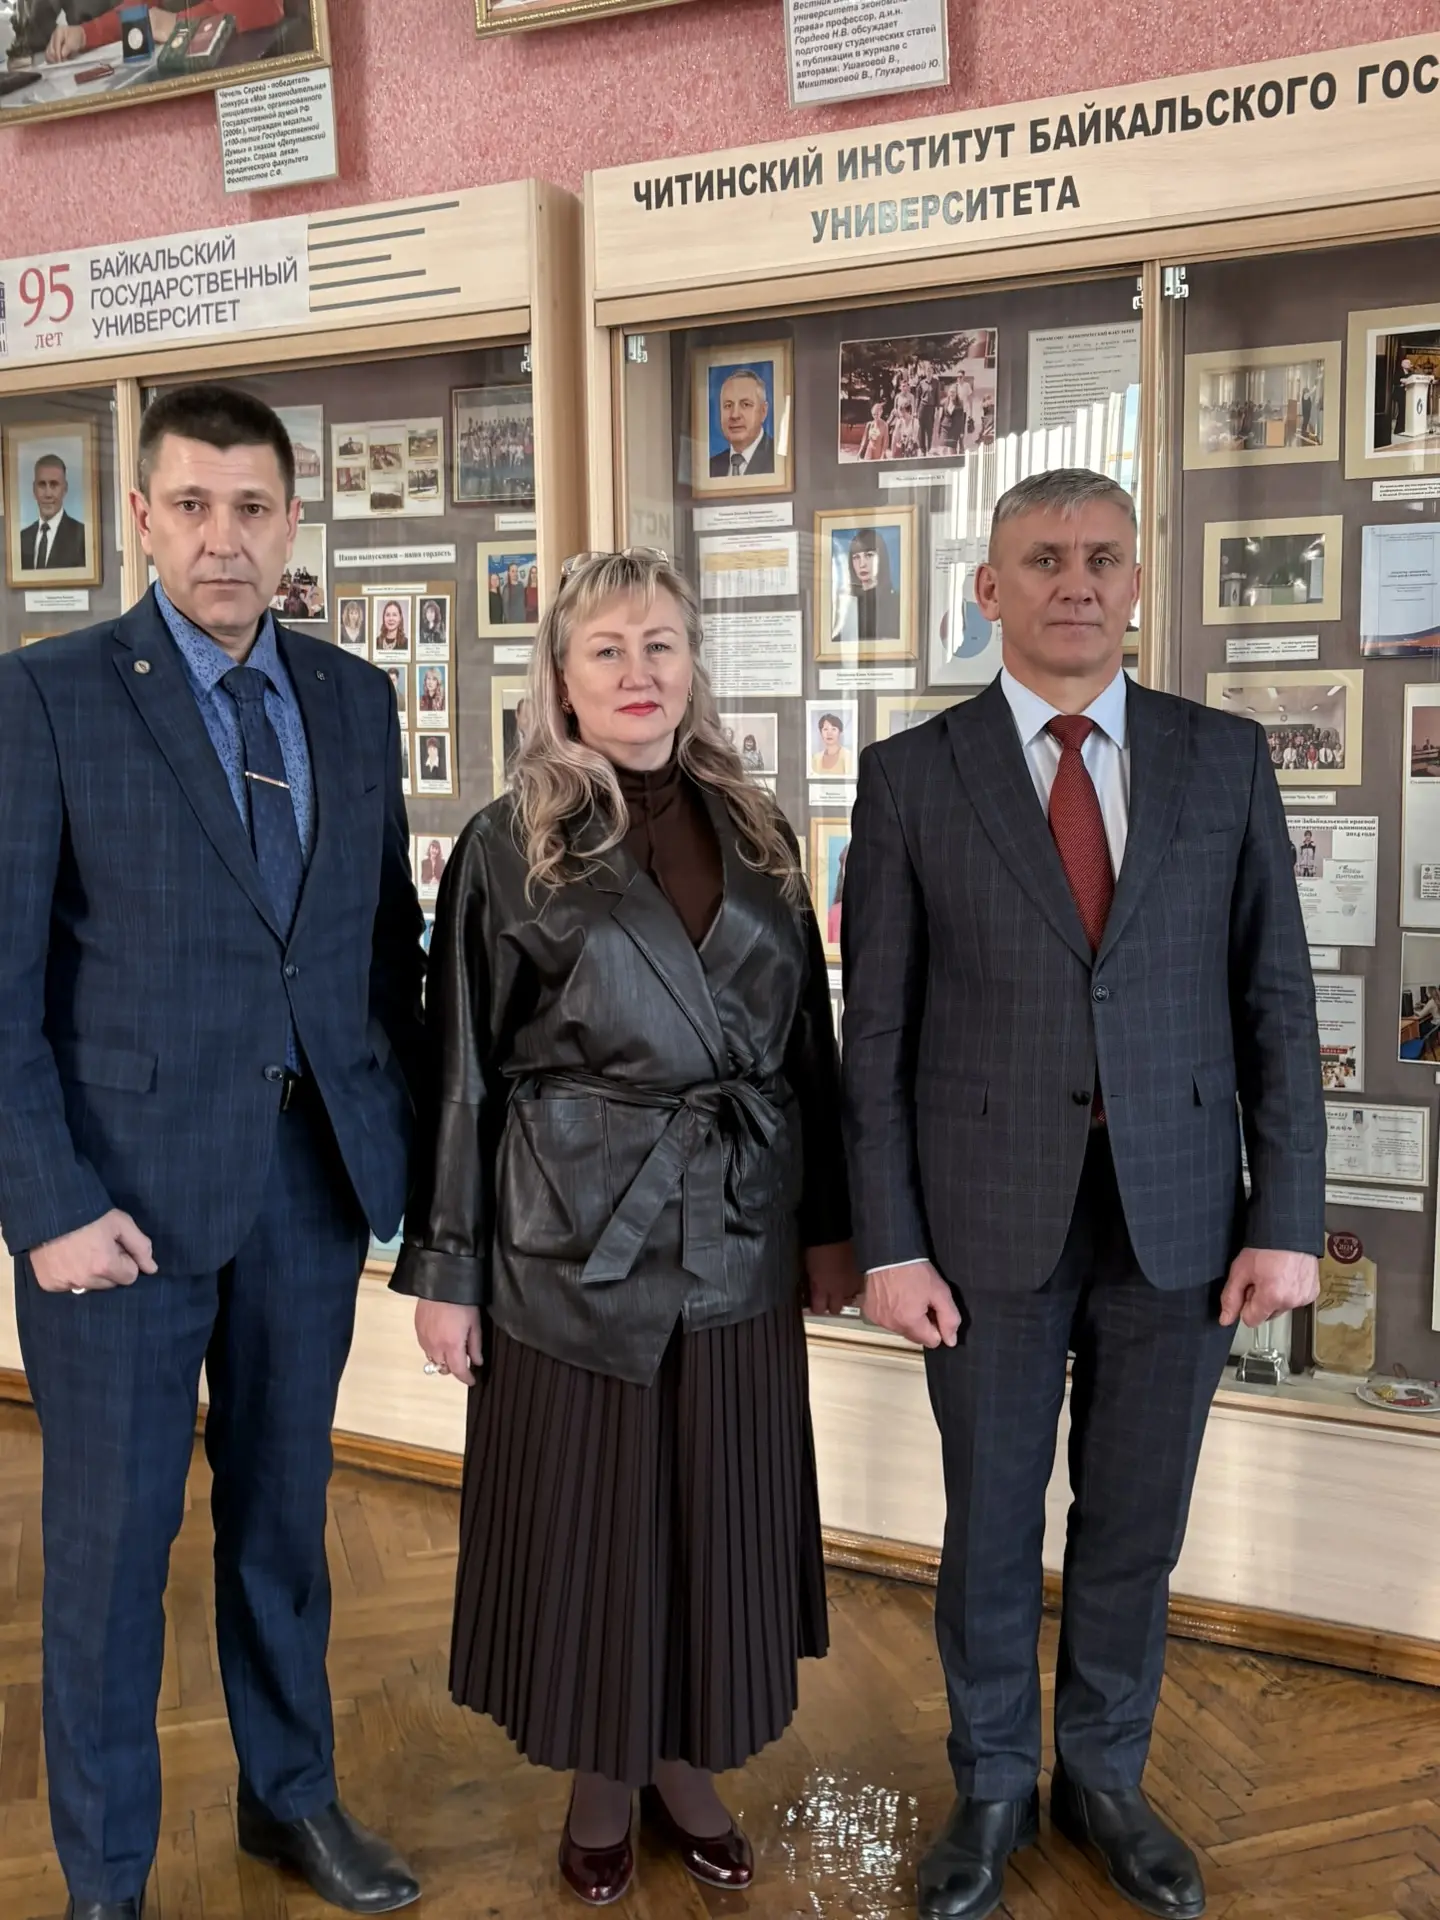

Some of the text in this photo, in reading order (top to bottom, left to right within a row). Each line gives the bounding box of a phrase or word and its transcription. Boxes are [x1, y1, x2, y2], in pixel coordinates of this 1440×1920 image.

[793, 4, 859, 24] университета
[794, 22, 823, 33] права»
[826, 13, 877, 28] профессор,
[795, 20, 898, 45] Гордеев Н.В. обсуждает
[795, 24, 937, 56] подготовку студенческих статей
[796, 67, 840, 79] авторами:
[842, 55, 886, 70] Ушаковой
[802, 52, 853, 66] публикации
[862, 44, 900, 58] журнале
[797, 72, 859, 90] Микитюковой
[875, 61, 927, 77] Глухаревой
[267, 93, 322, 110] организованного
[277, 107, 298, 118] думой
[633, 54, 1440, 211] ЧИТИНСКИЙ ИНСТИТУТ БАЙКАЛЬСКОГО ГОС
[810, 175, 1081, 244] УНИВЕРСИТЕТА
[89, 234, 236, 281] БАЙКАЛЬСКИЙ
[18, 263, 74, 327] 95
[90, 256, 298, 310] ГОСУДАРСТВЕННЫЙ
[92, 299, 241, 339] УНИВЕРСИТЕТ
[34, 331, 64, 350] лет
